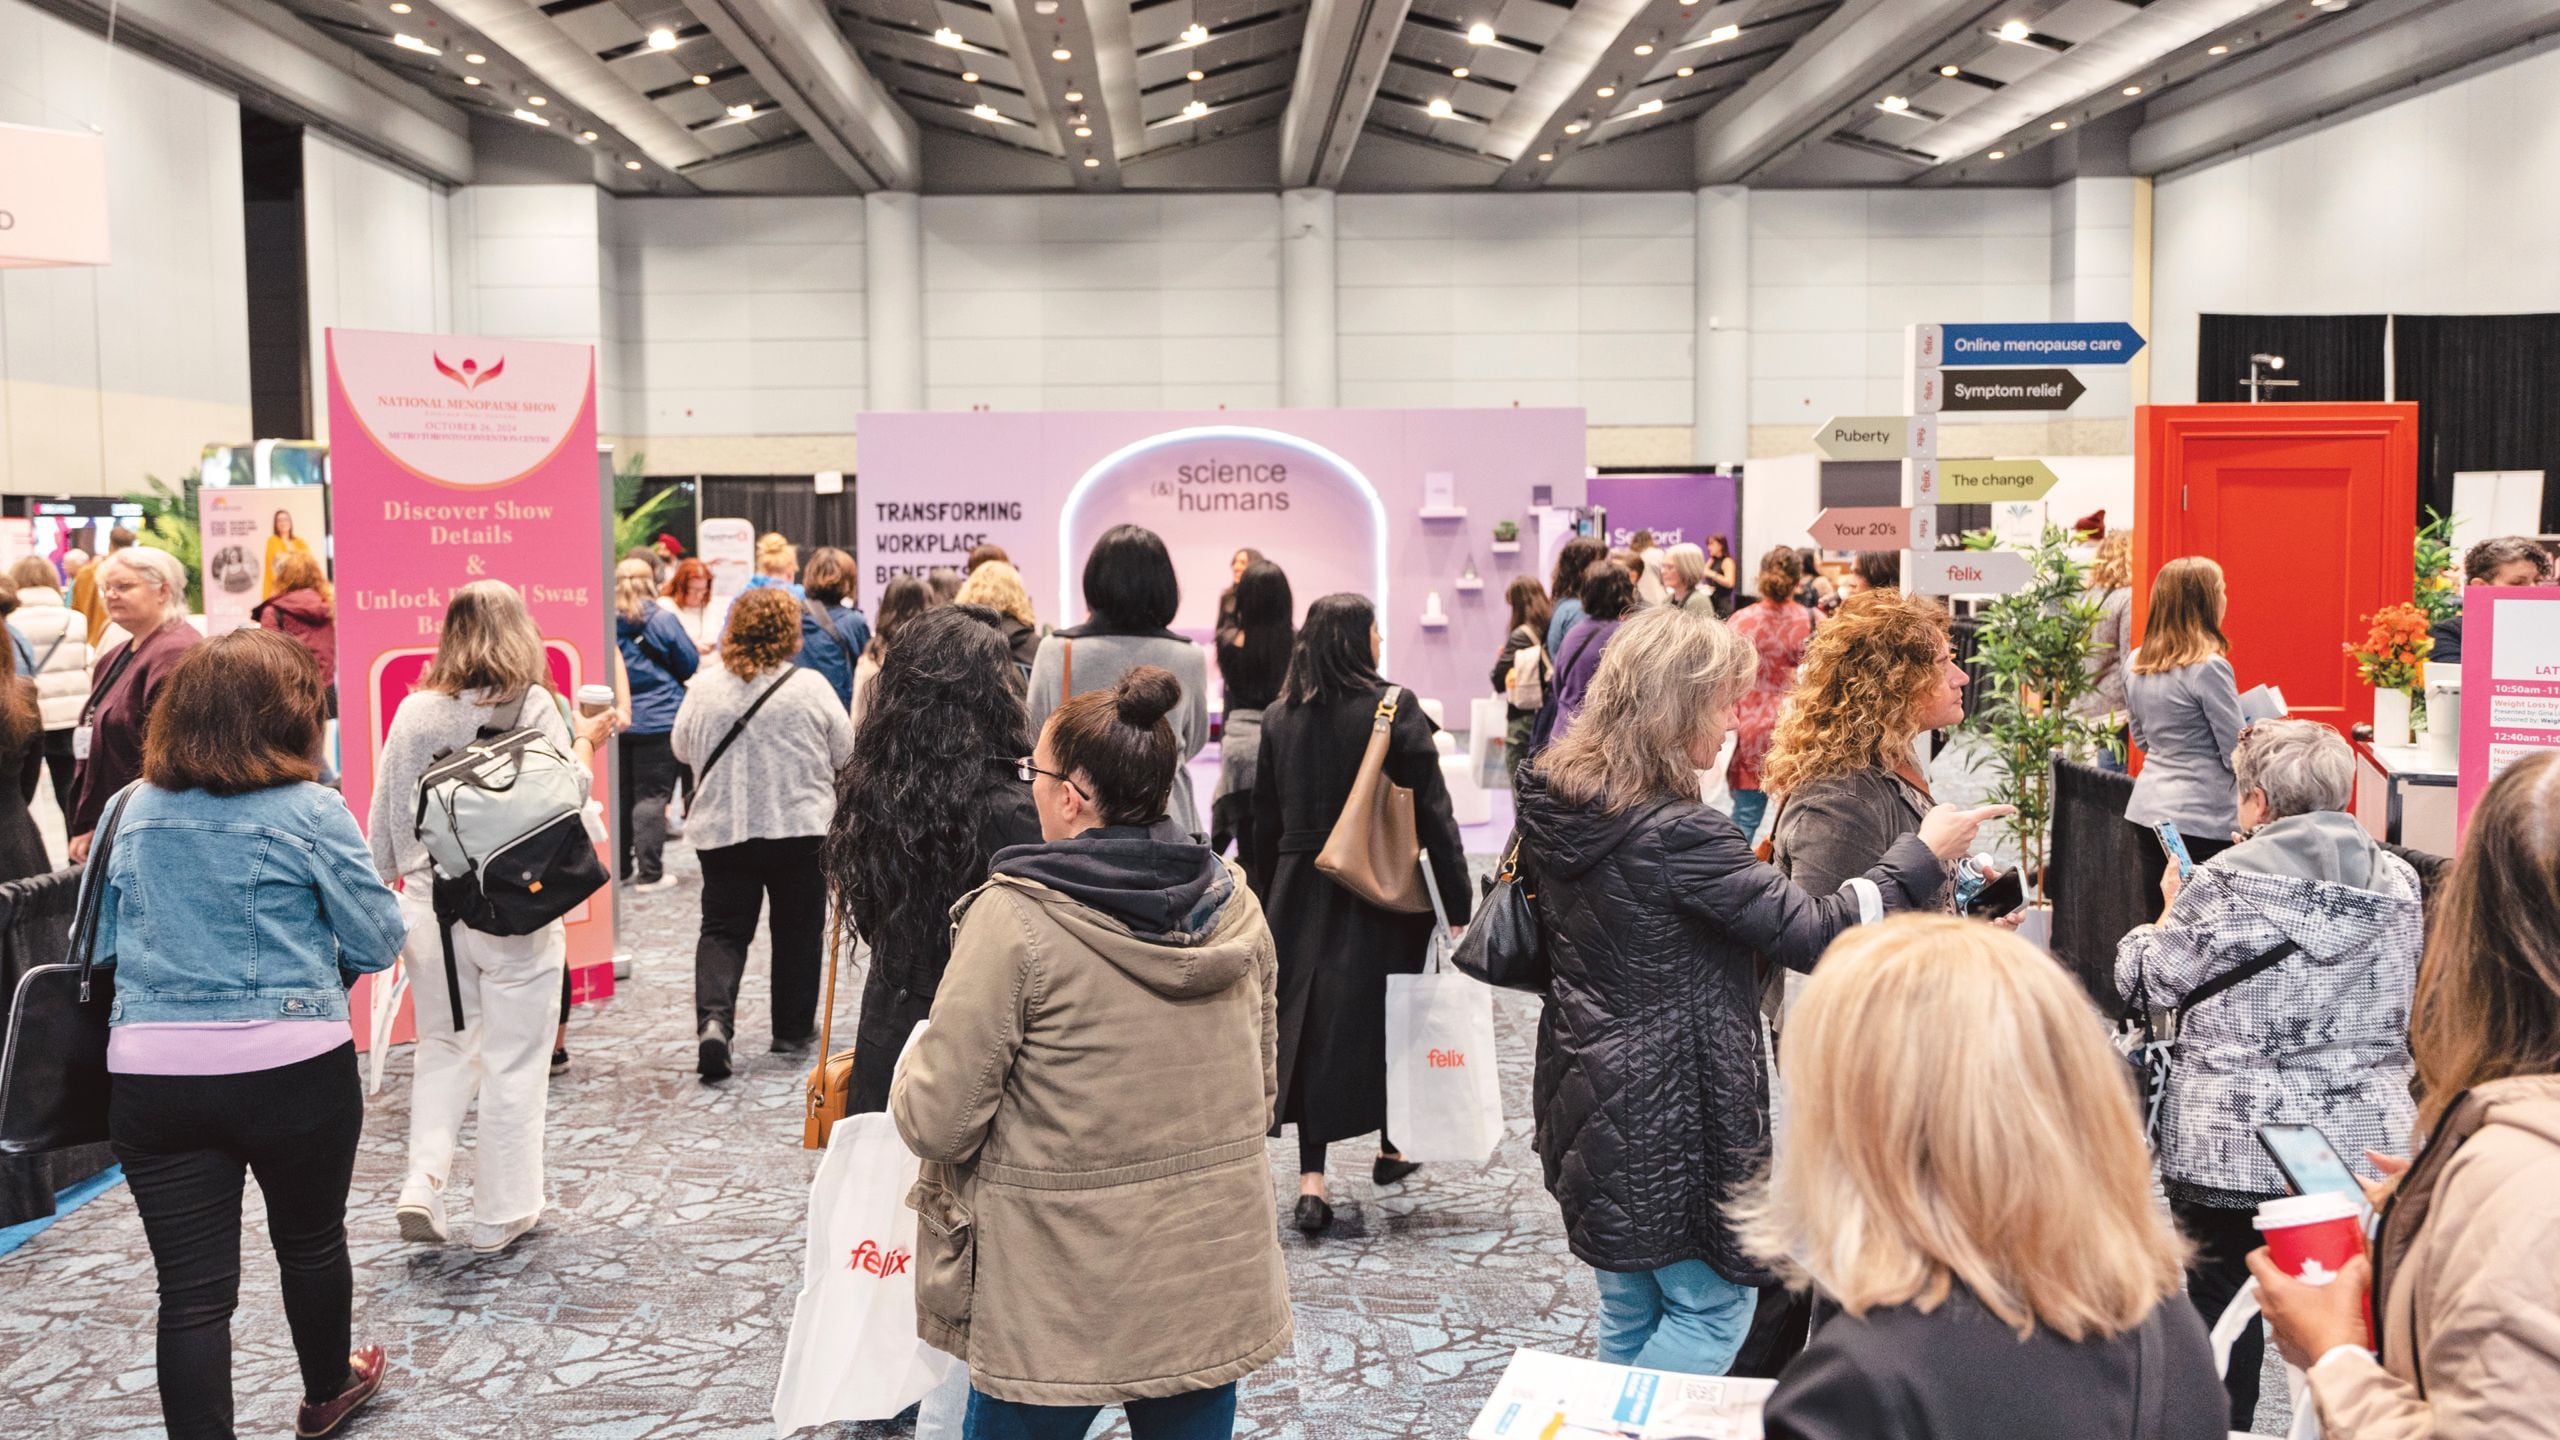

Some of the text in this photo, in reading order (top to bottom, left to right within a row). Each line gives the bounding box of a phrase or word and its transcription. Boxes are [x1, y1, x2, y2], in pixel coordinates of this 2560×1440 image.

[1924, 335, 1933, 355] felix
[1954, 337, 2122, 354] Online menopause care
[1924, 380, 1933, 401] felix
[1954, 383, 2063, 400] Symptom relief
[378, 395, 557, 413] NATIONAL MENOPAUSE SHOW
[425, 421, 477, 431] OCTOBER
[1835, 428, 1890, 445] Puberty
[1178, 459, 1287, 485] science
[1920, 470, 1931, 493] felix
[1952, 474, 2034, 489] The change
[1178, 488, 1290, 512] humans
[383, 499, 553, 521] Discover Show
[875, 502, 1022, 522] TRANSFORMING
[430, 525, 513, 546] Details
[1834, 522, 1897, 536] Your 20's
[465, 553, 486, 576] &
[1946, 565, 1982, 581] felix
[356, 587, 442, 611] Unlock
[532, 584, 589, 607] Swag
[2495, 684, 2541, 694] 10:50am
[2494, 700, 2526, 709] Weight
[2548, 702, 2559, 710] by
[2494, 716, 2529, 724] Sponsored
[2494, 732, 2540, 742] 12:40am
[1426, 1048, 1465, 1068] felix
[851, 1239, 911, 1279] felix
